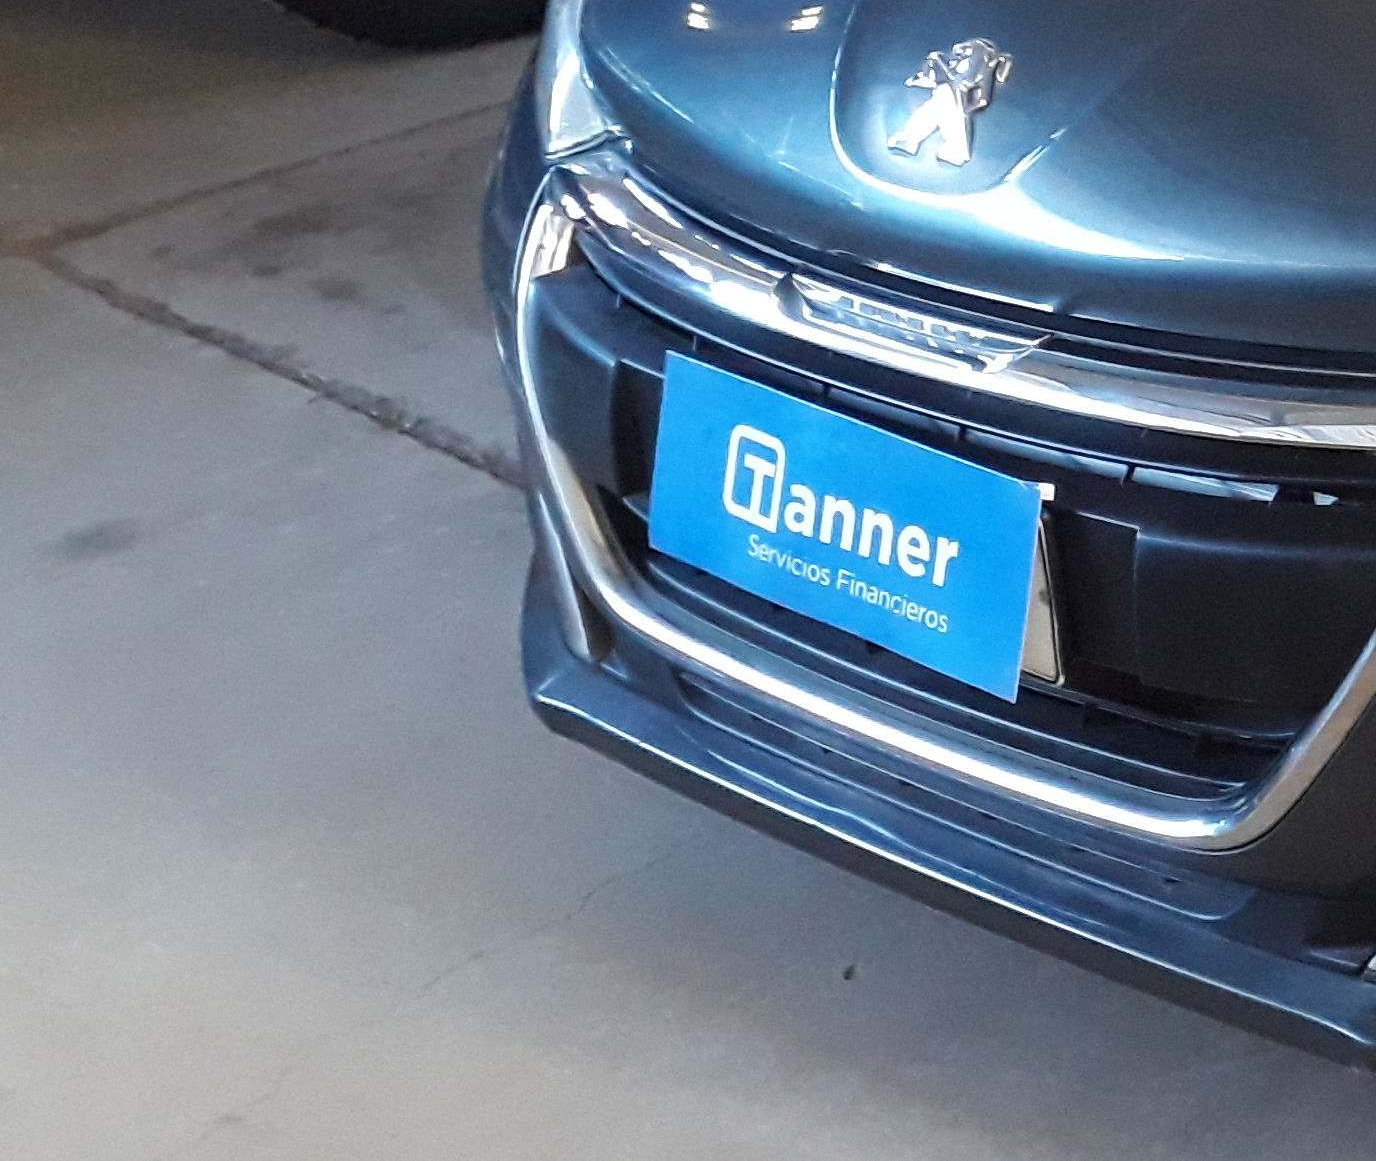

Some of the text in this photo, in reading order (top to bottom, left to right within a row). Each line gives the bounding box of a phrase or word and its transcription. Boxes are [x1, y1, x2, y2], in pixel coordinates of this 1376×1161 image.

[722, 423, 959, 588] Tanner
[747, 533, 949, 634] Servicios Financieros
